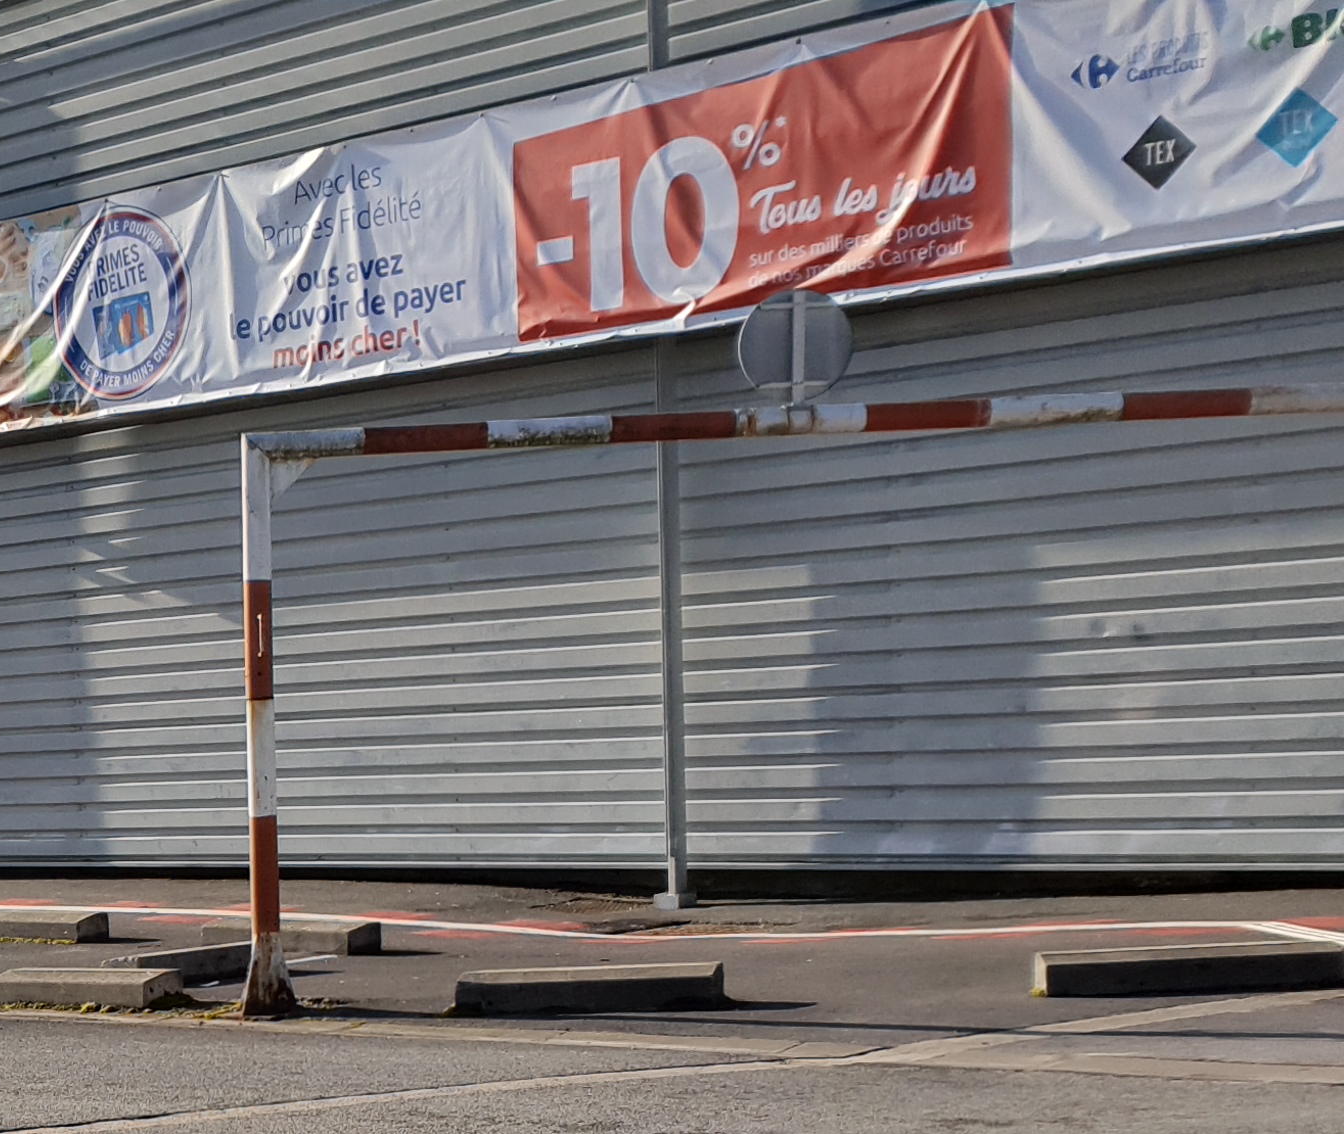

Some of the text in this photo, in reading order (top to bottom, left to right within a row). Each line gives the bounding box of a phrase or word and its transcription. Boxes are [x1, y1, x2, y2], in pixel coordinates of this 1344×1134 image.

[1126, 57, 1207, 82] Carrefour
[1144, 138, 1176, 166] TEX
[294, 164, 383, 205] Avec les
[750, 165, 977, 234] Tous les jours
[108, 219, 120, 234] LE
[123, 220, 163, 250] POUVOIR
[262, 191, 422, 250] Primes Fidélité
[536, 135, 740, 312] -10
[749, 250, 775, 268] sur
[777, 242, 807, 261] des
[810, 232, 871, 256] milliers
[896, 213, 975, 244] produits
[283, 253, 404, 296] vous avez
[748, 270, 769, 288] de
[770, 269, 803, 284] nos
[879, 239, 968, 267] Carrefour
[229, 279, 467, 342] le pouvoir de payer
[80, 329, 176, 388] DE PAYER MOINS CHER
[272, 335, 345, 369] moins
[351, 325, 408, 356] cher
